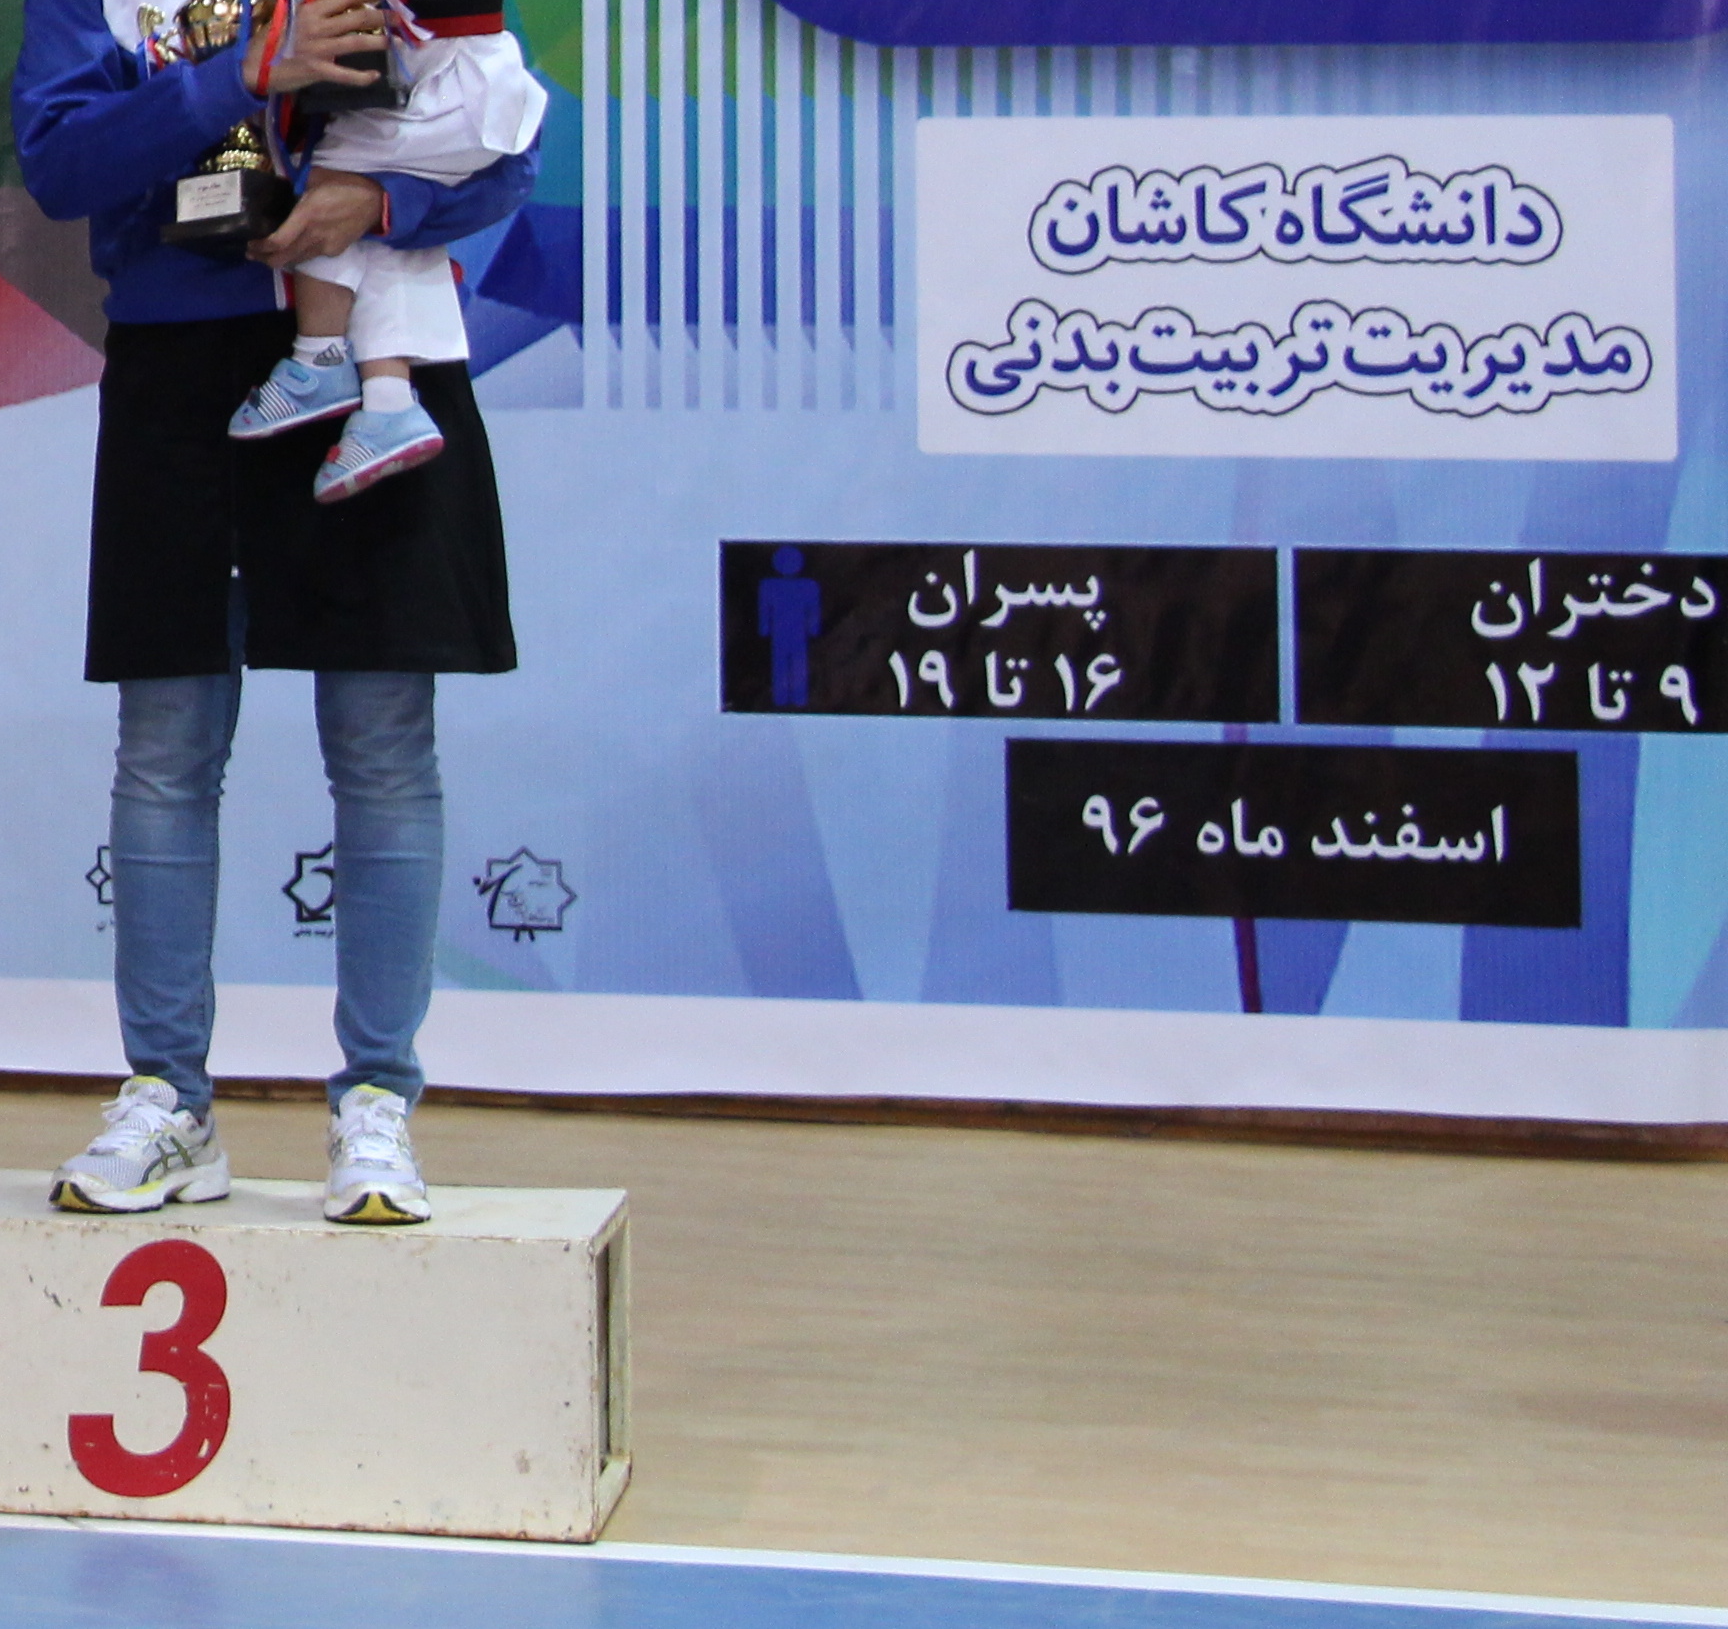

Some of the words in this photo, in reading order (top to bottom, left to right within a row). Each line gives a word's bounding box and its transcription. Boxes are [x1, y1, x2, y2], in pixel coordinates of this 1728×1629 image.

[1044, 178, 1266, 258] کاشان
[1277, 170, 1544, 250] دانشگاه
[964, 308, 1121, 397] بدنی
[1126, 315, 1328, 400] تربیت
[1342, 323, 1634, 402] مدیریت
[906, 548, 1102, 633] پسران
[1469, 558, 1718, 638] دختران
[985, 649, 1028, 710] تا
[1588, 660, 1629, 722] تا
[1196, 799, 1285, 858] ماه
[1310, 804, 1505, 865] اسفند
[66, 1237, 231, 1498] 3
